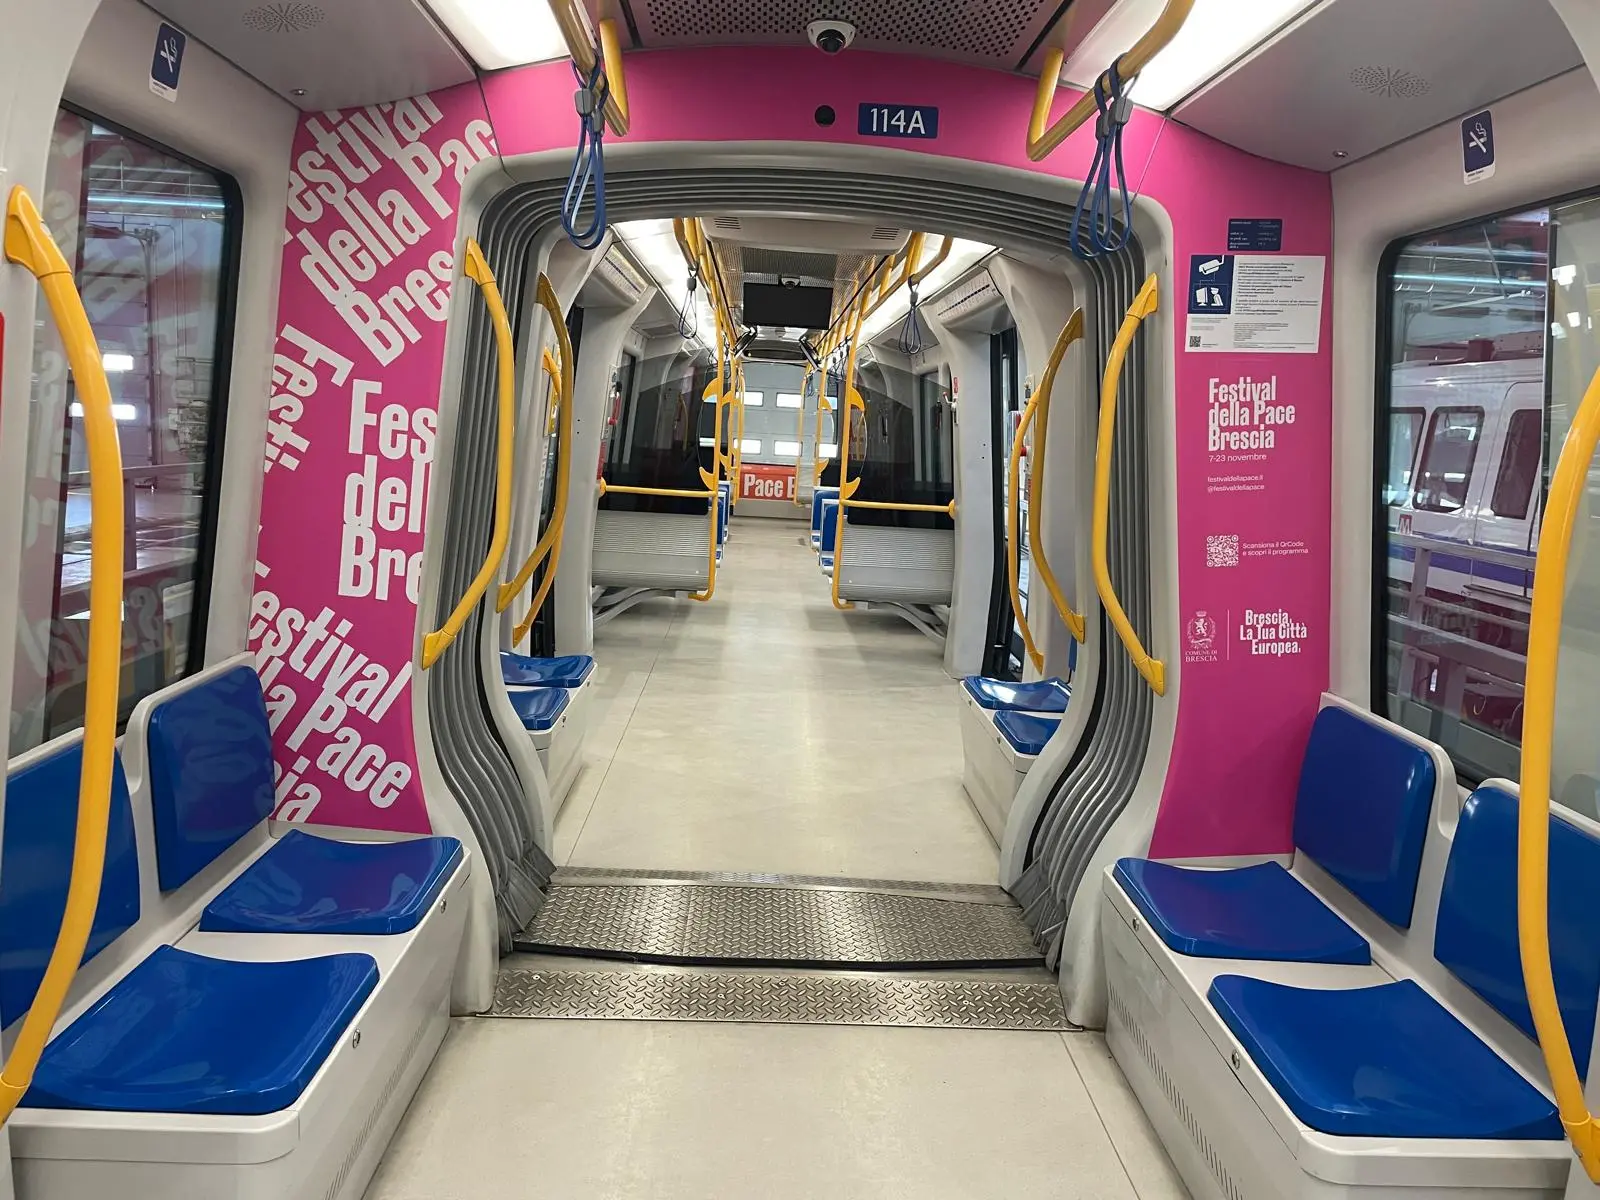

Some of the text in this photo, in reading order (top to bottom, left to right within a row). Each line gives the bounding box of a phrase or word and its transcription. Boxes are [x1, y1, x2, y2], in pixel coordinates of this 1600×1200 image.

[870, 108, 926, 135] 114A
[297, 188, 432, 306] della
[334, 250, 456, 367] Bres
[1209, 375, 1277, 403] Festival
[1208, 401, 1296, 427] della Pace
[1208, 424, 1275, 452] Brescia
[1208, 453, 1267, 463] 7-23 novembre
[343, 455, 432, 534] del
[743, 473, 784, 498] Pace
[1247, 549, 1267, 557] scopri
[1272, 548, 1309, 556] programma
[1280, 540, 1304, 548] QrCode
[250, 560, 413, 724] estival
[1240, 621, 1307, 641] La Tua Città
[1185, 655, 1218, 663] BRESCIA
[285, 688, 412, 809] Pace
